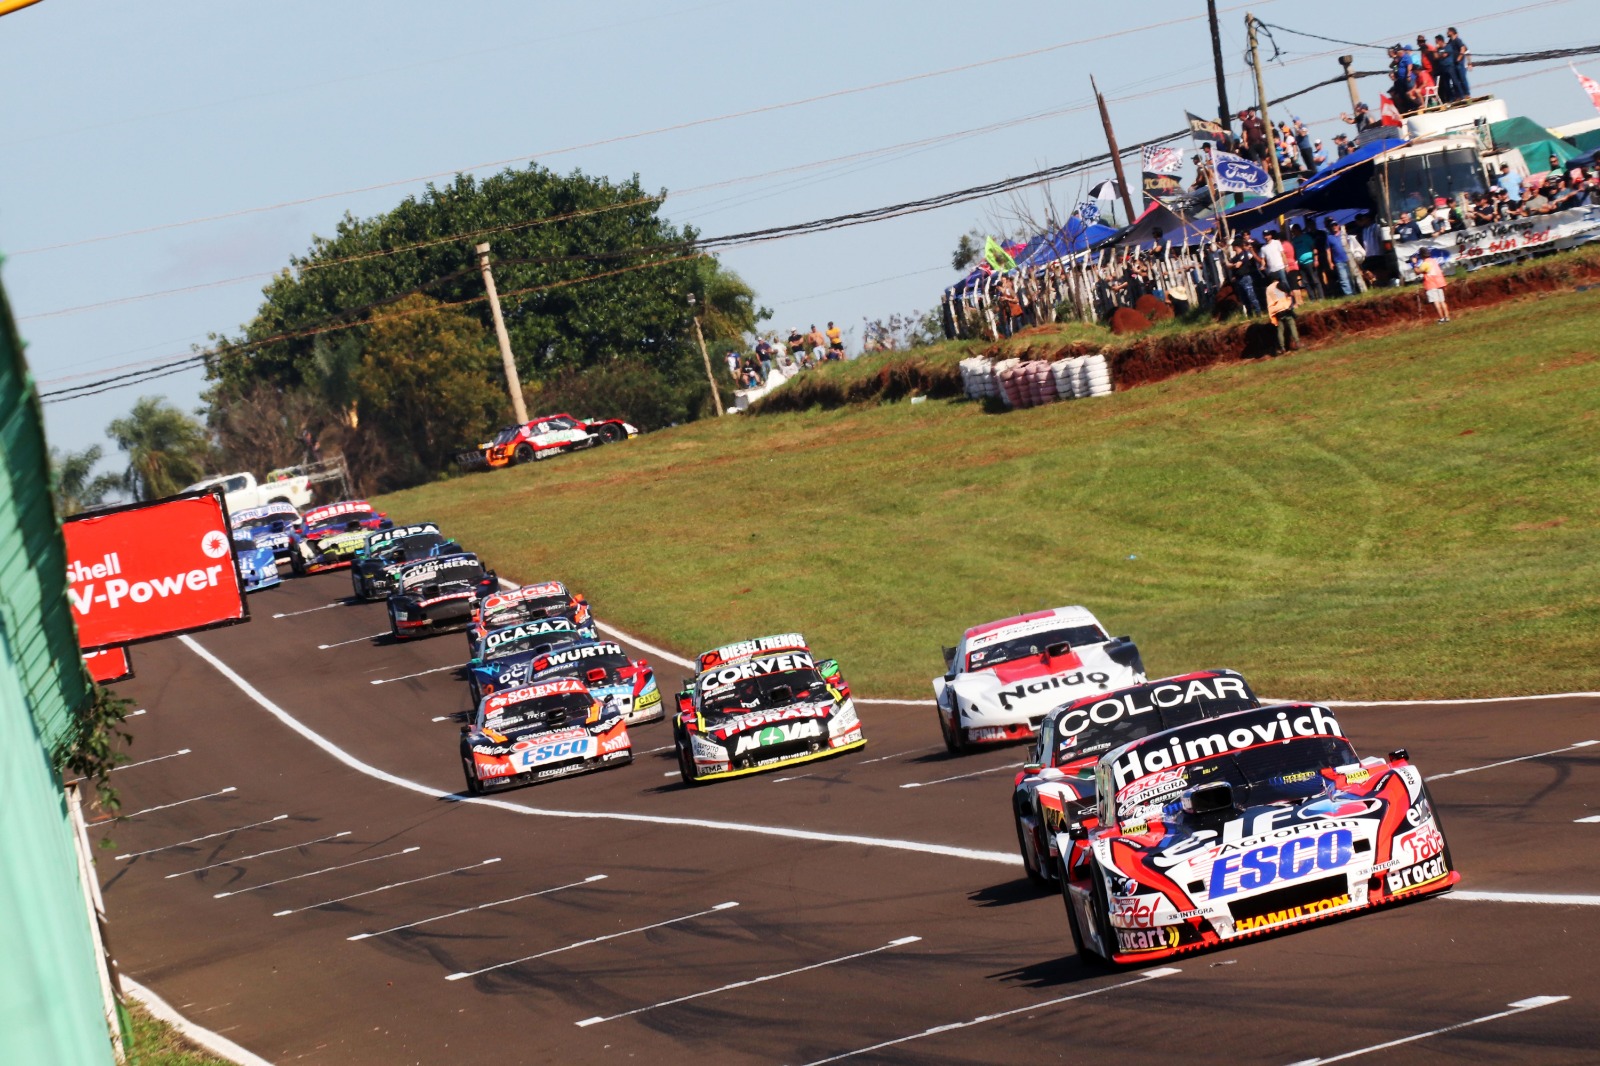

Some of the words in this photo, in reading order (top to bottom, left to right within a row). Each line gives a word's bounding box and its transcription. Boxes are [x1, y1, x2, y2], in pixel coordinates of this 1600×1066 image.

[66, 552, 121, 584] Shell
[66, 564, 223, 616] V-Power
[486, 622, 552, 648] OCASA
[719, 639, 760, 661] DIESEL
[701, 654, 815, 691] CORVEN
[998, 671, 1110, 704] Naldo
[507, 680, 583, 701] SCIENZA
[724, 706, 823, 737] FIORASI
[1058, 677, 1249, 737] COLCAR
[522, 739, 589, 766] ESCO
[1113, 707, 1343, 791] Haimovich
[1140, 779, 1186, 800] INTEGRA
[1123, 824, 1148, 834] KAESER
[1209, 829, 1353, 900] ESCO
[1370, 859, 1401, 872] INTEGRA
[1180, 907, 1215, 921] INTEGRA
[1236, 894, 1350, 932] HAMILTON
